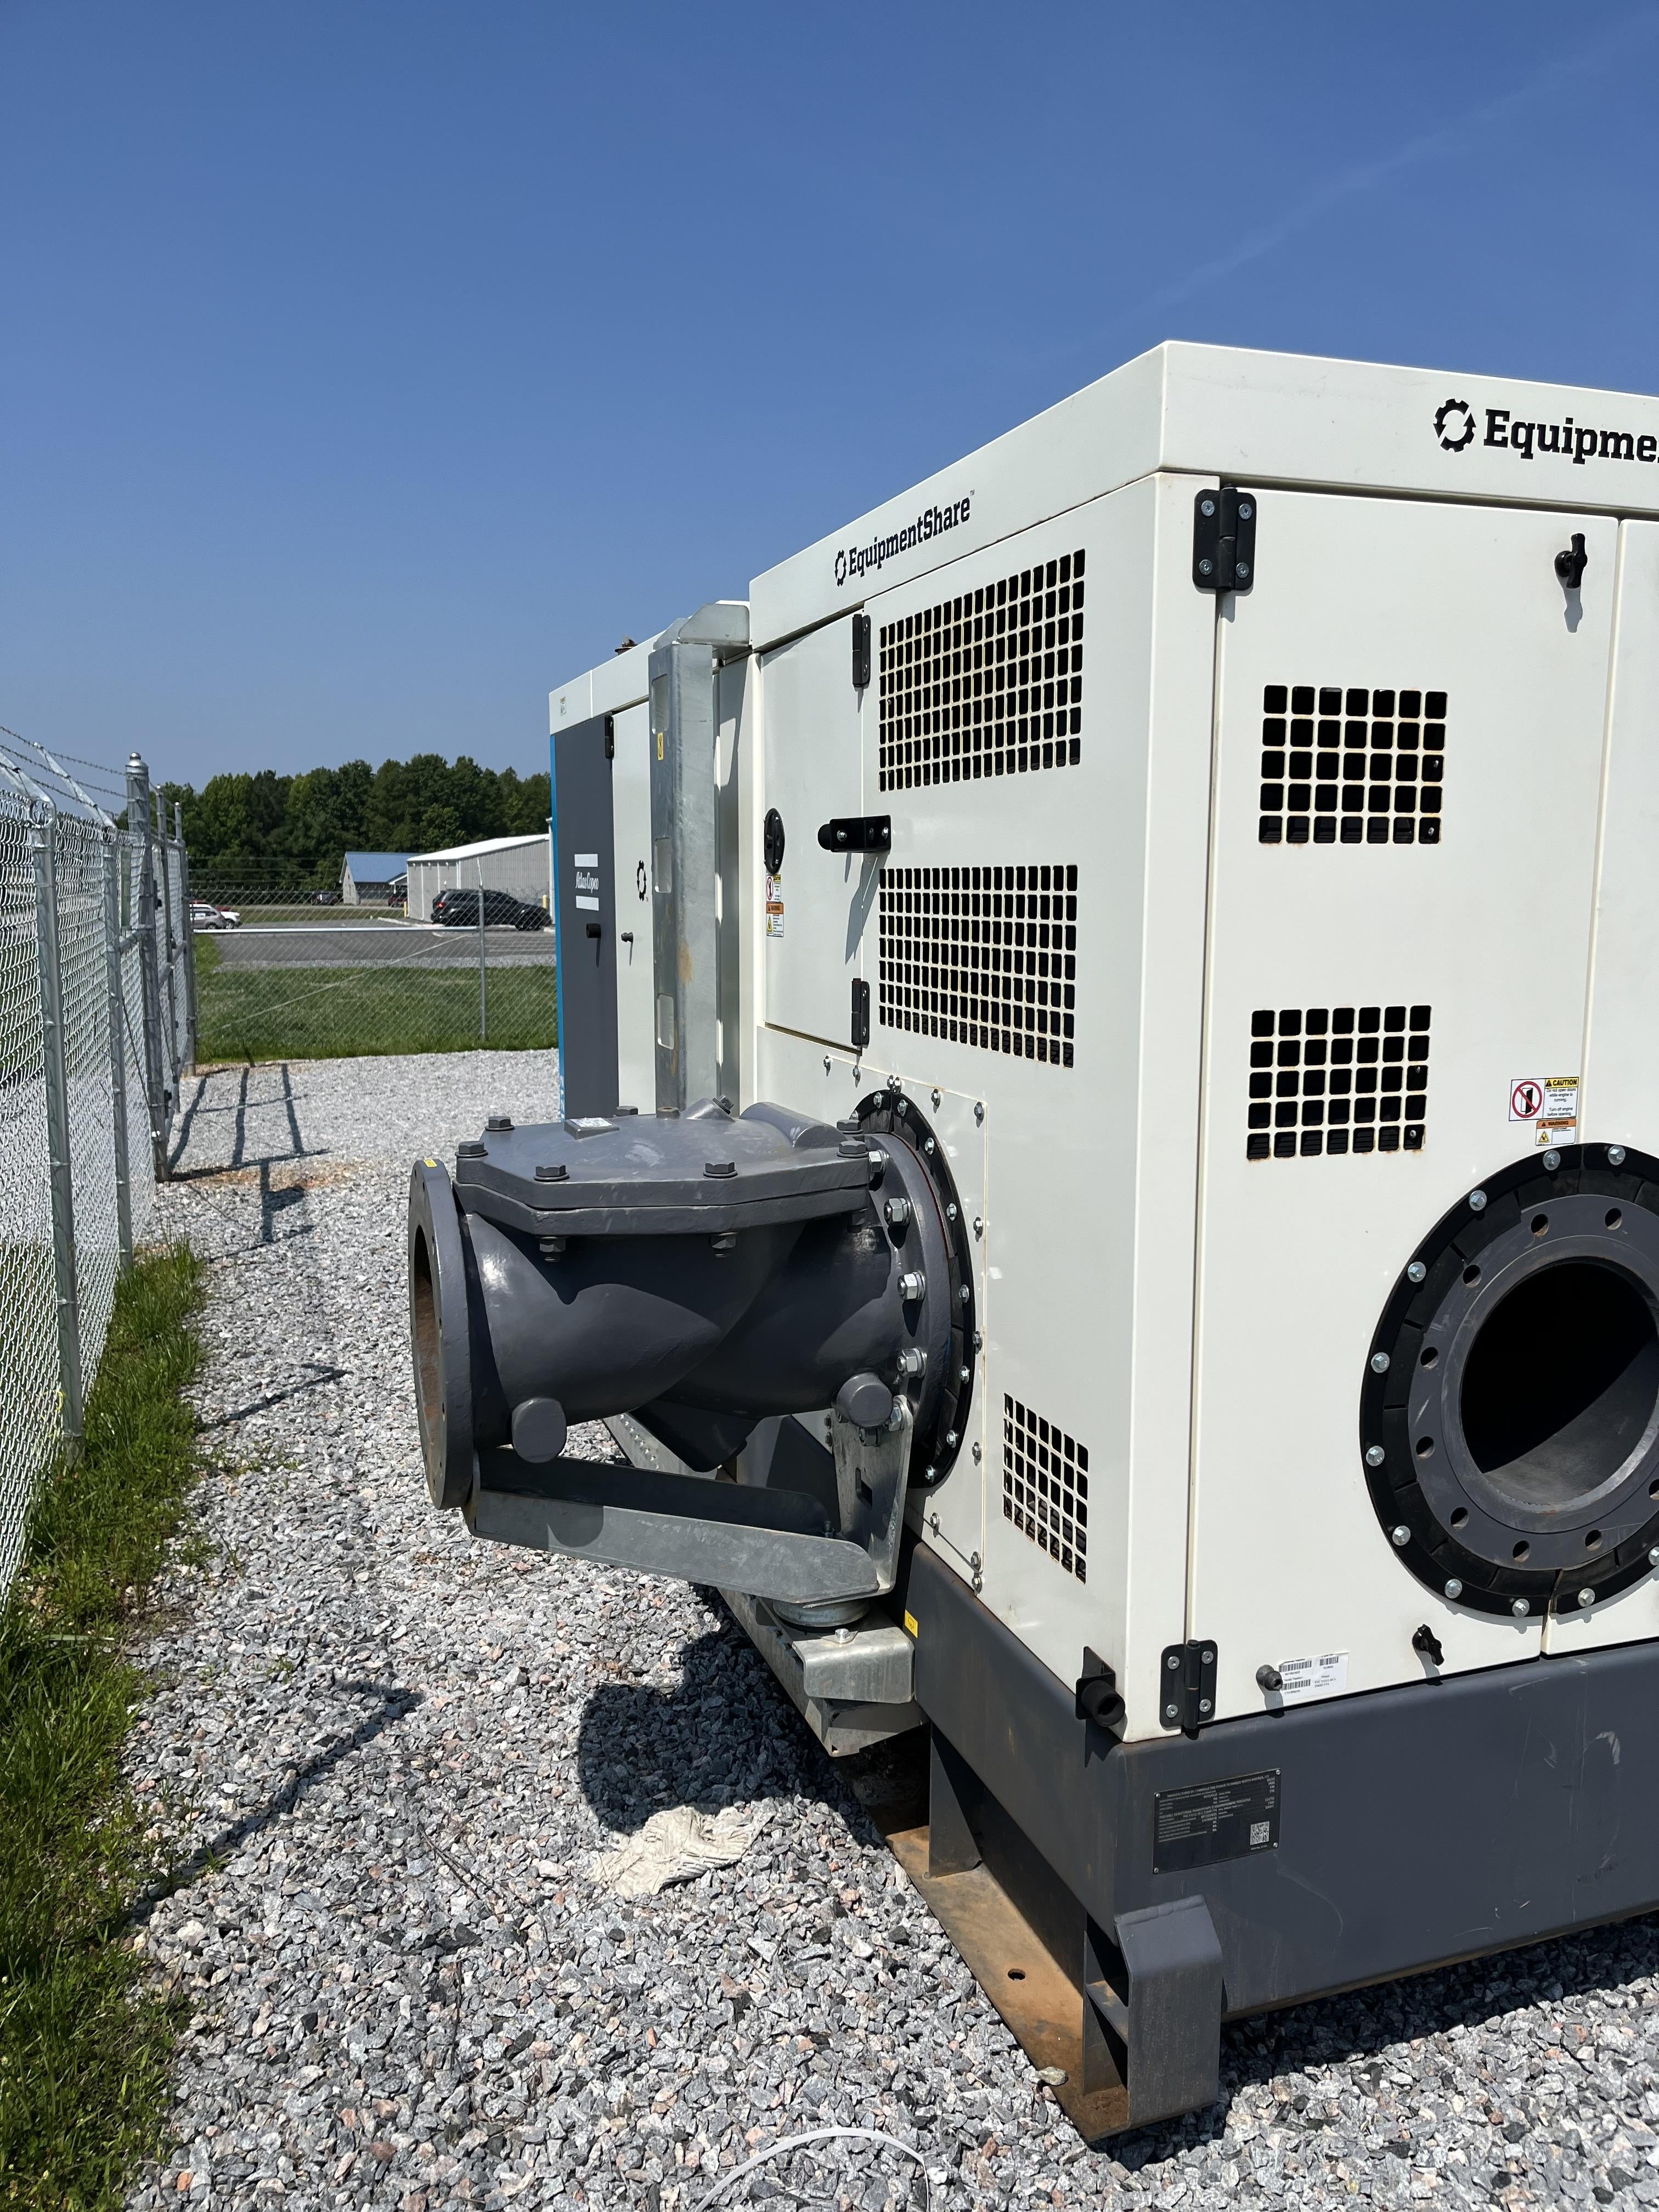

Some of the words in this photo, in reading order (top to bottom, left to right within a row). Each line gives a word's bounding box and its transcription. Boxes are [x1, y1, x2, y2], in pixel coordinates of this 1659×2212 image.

[1483, 409, 1659, 465] Equipme
[849, 496, 970, 578] EquipmentShare
[575, 871, 587, 889] Atlas
[587, 871, 599, 894] Copco
